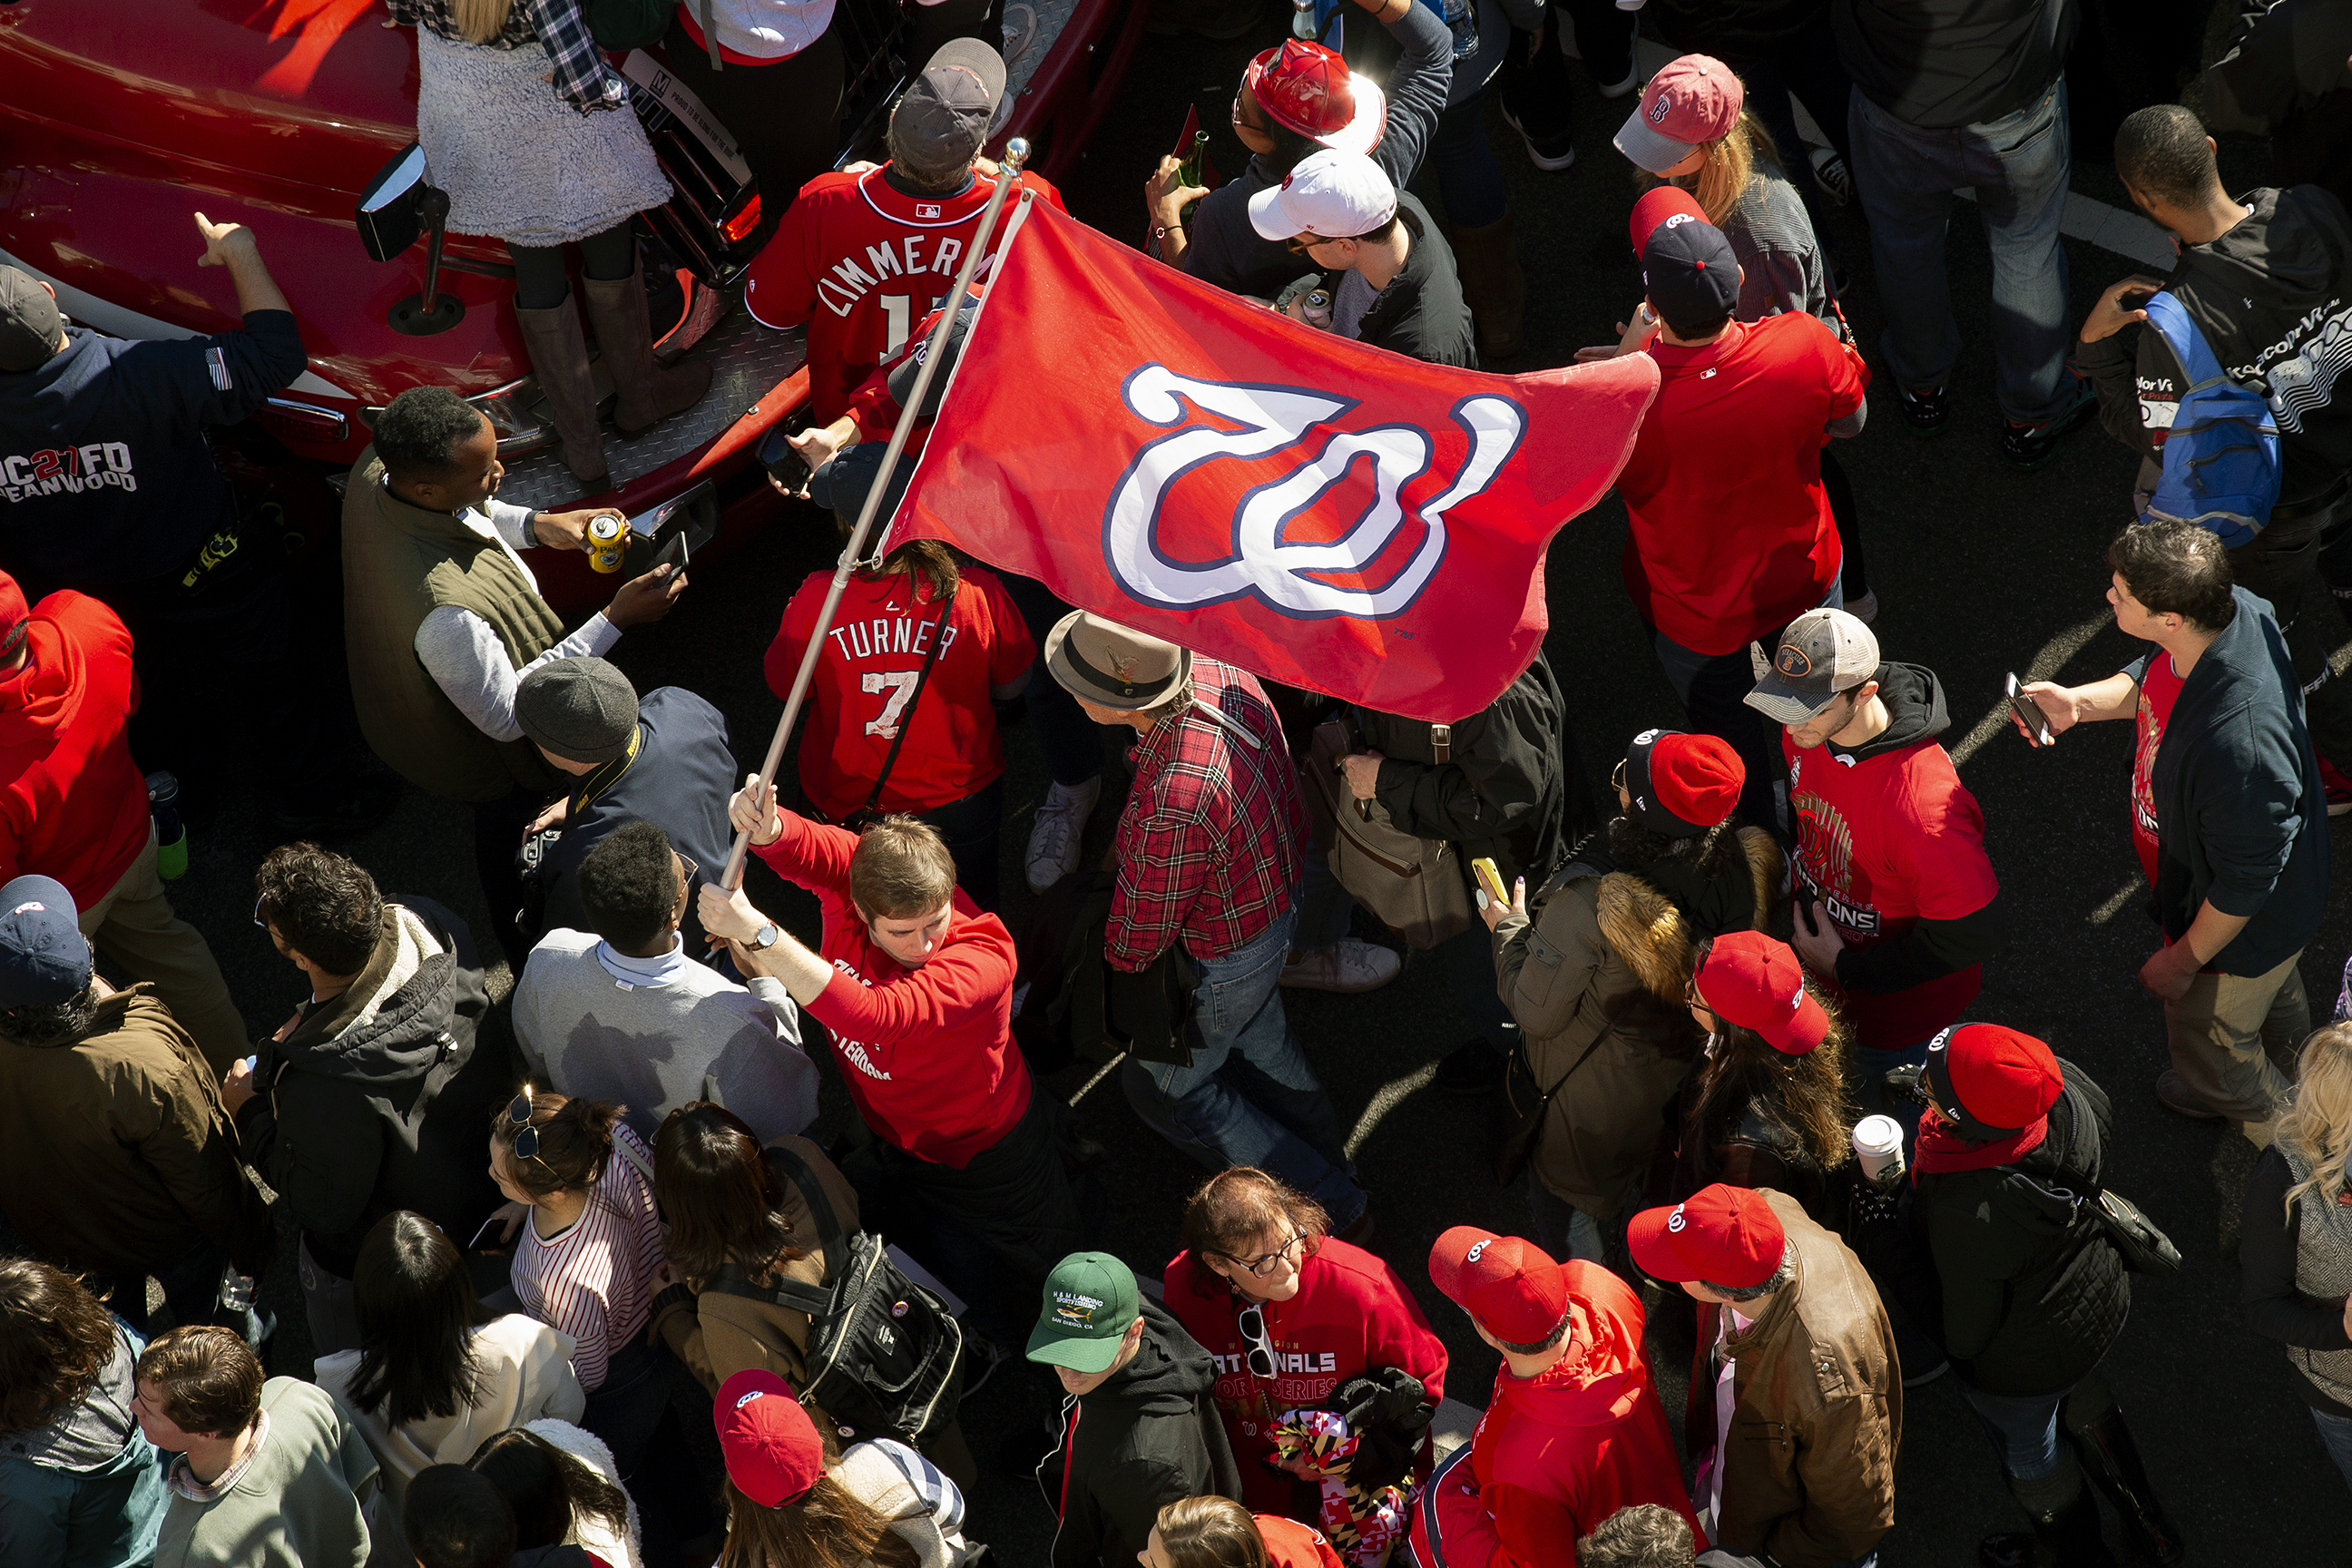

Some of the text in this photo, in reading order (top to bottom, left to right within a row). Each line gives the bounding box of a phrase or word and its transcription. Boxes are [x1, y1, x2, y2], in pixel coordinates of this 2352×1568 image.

[1649, 94, 1671, 123] B
[670, 91, 689, 110] PROUD
[685, 106, 694, 115] TO
[691, 113, 701, 122] BE
[708, 131, 720, 142] FOR
[715, 139, 727, 150] THE
[828, 617, 957, 661] TURNER
[1394, 628, 1415, 640] TM
[1781, 649, 1806, 666] SYRACUSE
[860, 670, 919, 740] 7
[1056, 1297, 1097, 1310] SPORTFISHING
[1073, 1294, 1103, 1307] LANDING
[1213, 1352, 1337, 1375] ATNALS
[1272, 1377, 1338, 1400] SERIES
